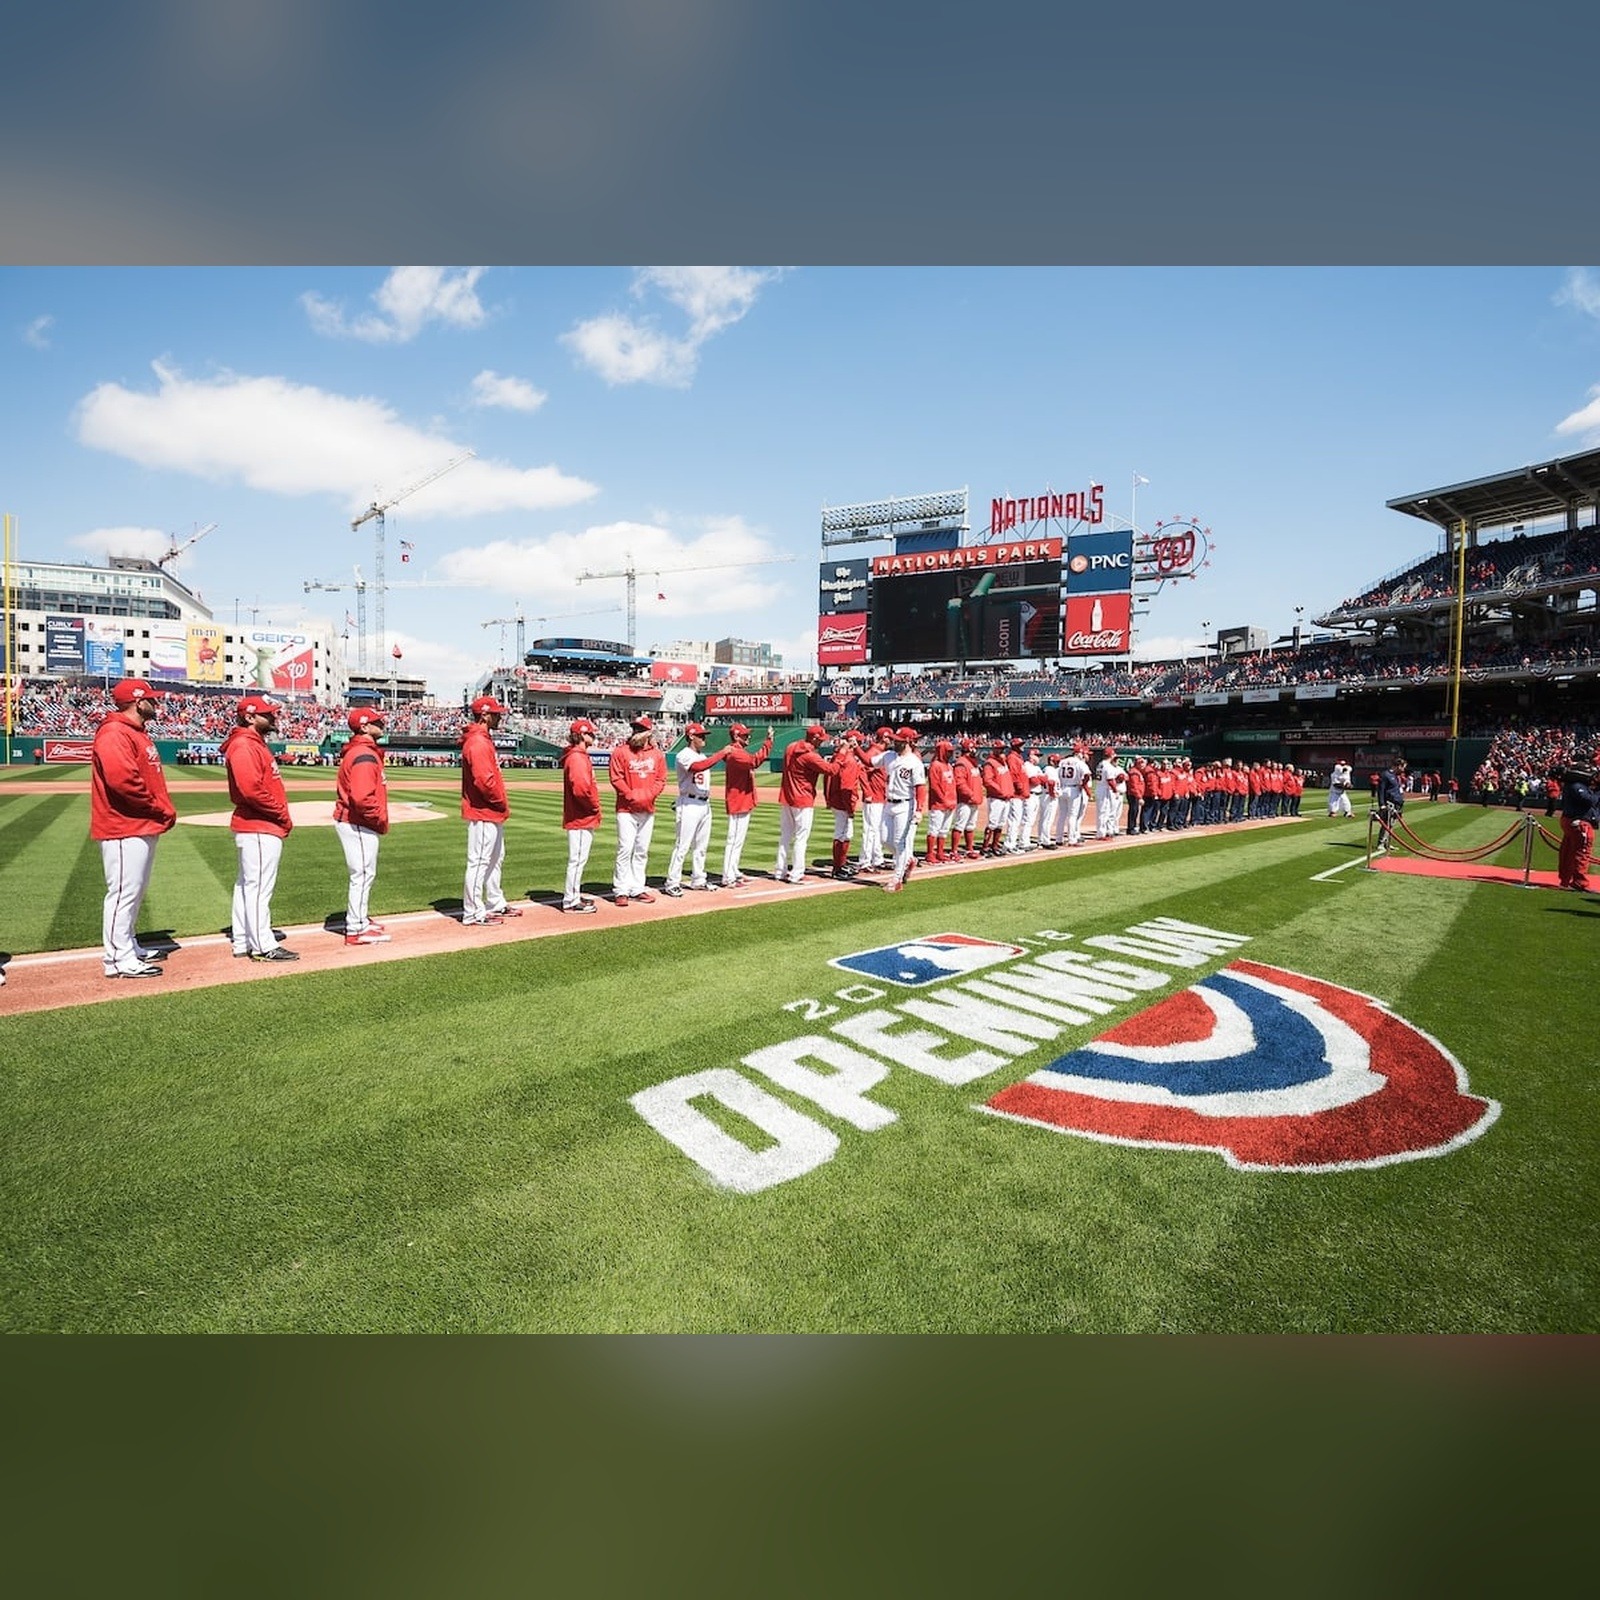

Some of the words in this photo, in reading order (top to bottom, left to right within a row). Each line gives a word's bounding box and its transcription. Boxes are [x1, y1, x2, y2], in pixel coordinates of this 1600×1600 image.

[991, 485, 1104, 535] NATIONALS
[878, 550, 988, 572] NATIONALS
[997, 542, 1051, 561] PARK
[1090, 552, 1130, 570] PNC
[252, 632, 306, 645] GEICO
[729, 694, 769, 708] TICKETS
[999, 700, 1042, 710] HARPER
[1384, 728, 1446, 738] nationals.com
[1061, 766, 1075, 779] 13
[627, 949, 1172, 1194] OPENING
[1081, 916, 1254, 969] DAY
